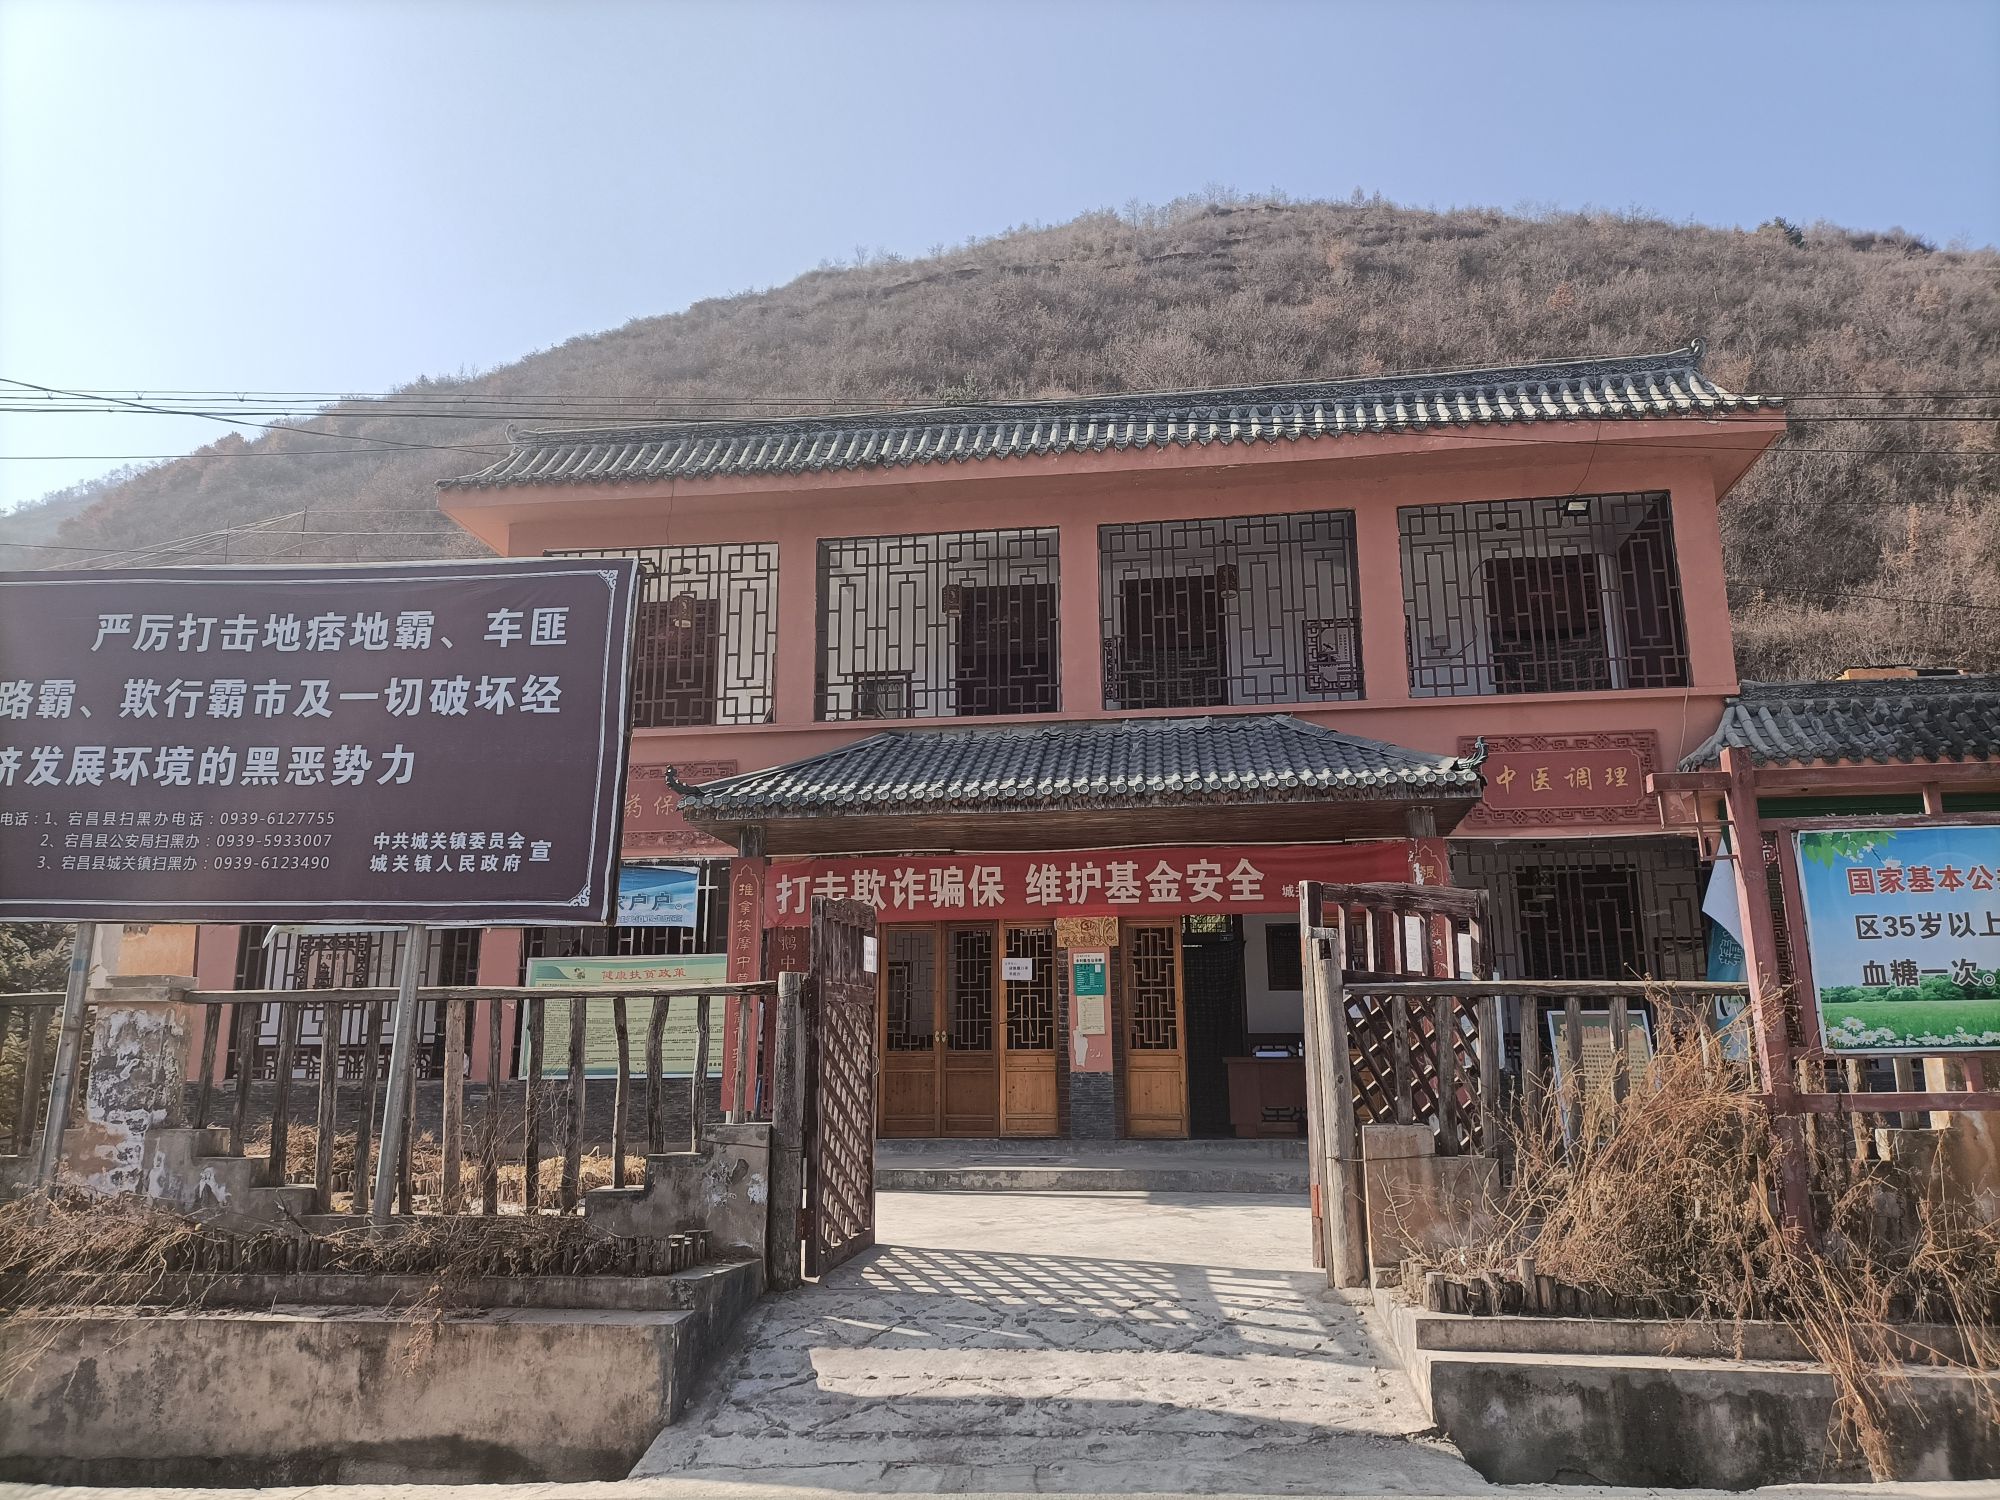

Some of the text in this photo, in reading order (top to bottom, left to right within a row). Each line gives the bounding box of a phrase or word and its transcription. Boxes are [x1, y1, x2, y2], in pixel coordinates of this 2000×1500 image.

[91, 606, 570, 653] 严厉打击地痞地霸、车匪
[1496, 765, 1629, 793] 中医调理
[373, 832, 525, 850] 中共城关镇委员会
[529, 840, 552, 863] 宣
[369, 853, 521, 872] 城关镇人民政府
[1025, 858, 1265, 905] 维护基金安全
[1846, 864, 2000, 895] 国家基本公
[1855, 911, 2000, 940] 区35岁以上
[1862, 958, 1996, 986] 血糖一次。
